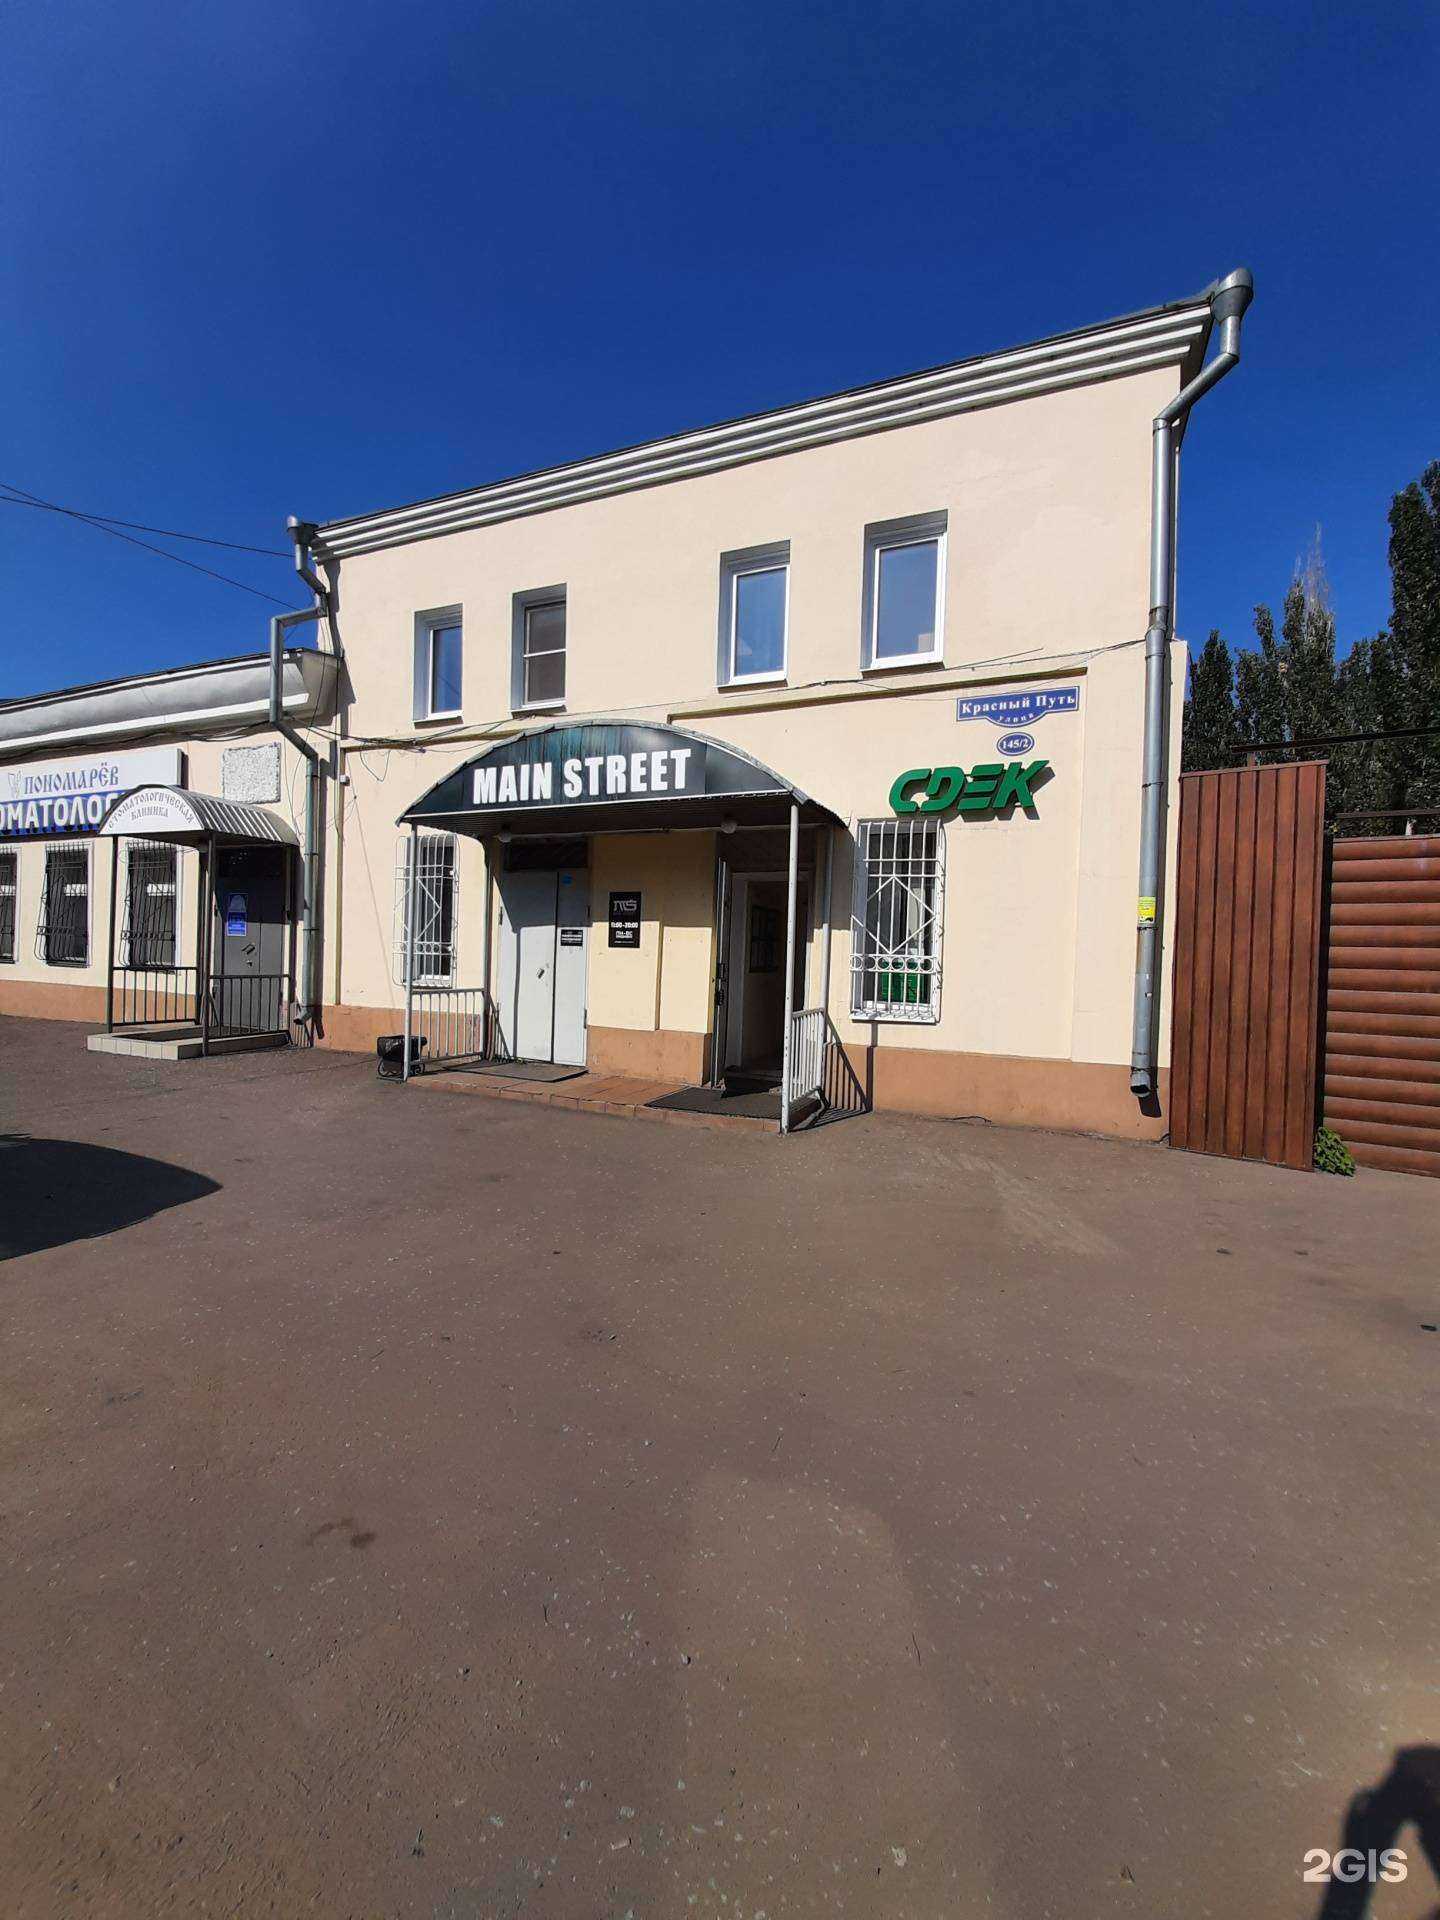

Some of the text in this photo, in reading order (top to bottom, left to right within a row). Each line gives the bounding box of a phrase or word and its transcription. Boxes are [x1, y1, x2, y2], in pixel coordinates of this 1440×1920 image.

[962, 694, 1075, 715] Красный Путь
[1002, 738, 1029, 749] 145/2
[24, 762, 119, 794] ПОНОМАРЁВ
[473, 748, 692, 804] MAIN STREET
[0, 792, 126, 830] МАТОЛОГ
